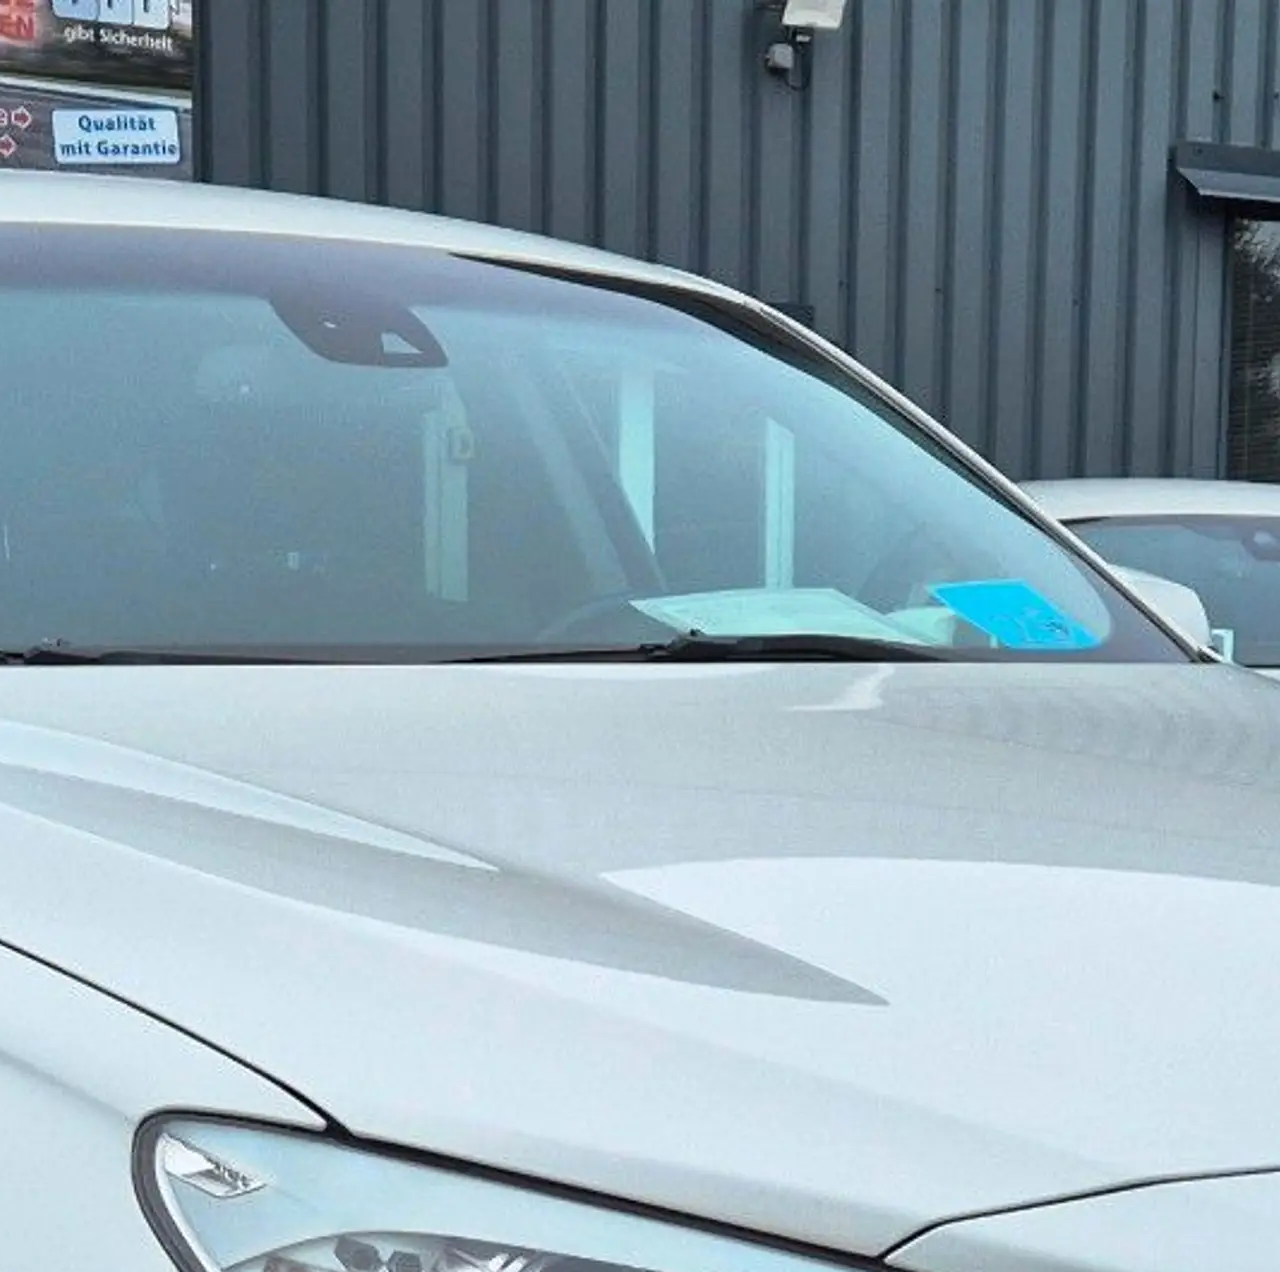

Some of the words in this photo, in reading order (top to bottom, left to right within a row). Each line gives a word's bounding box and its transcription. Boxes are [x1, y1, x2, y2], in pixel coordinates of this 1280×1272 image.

[63, 25, 95, 43] gibt
[99, 27, 174, 51] Sicherheit
[78, 115, 156, 132] Qualität
[60, 141, 92, 155] mit
[96, 141, 177, 155] Garantie
